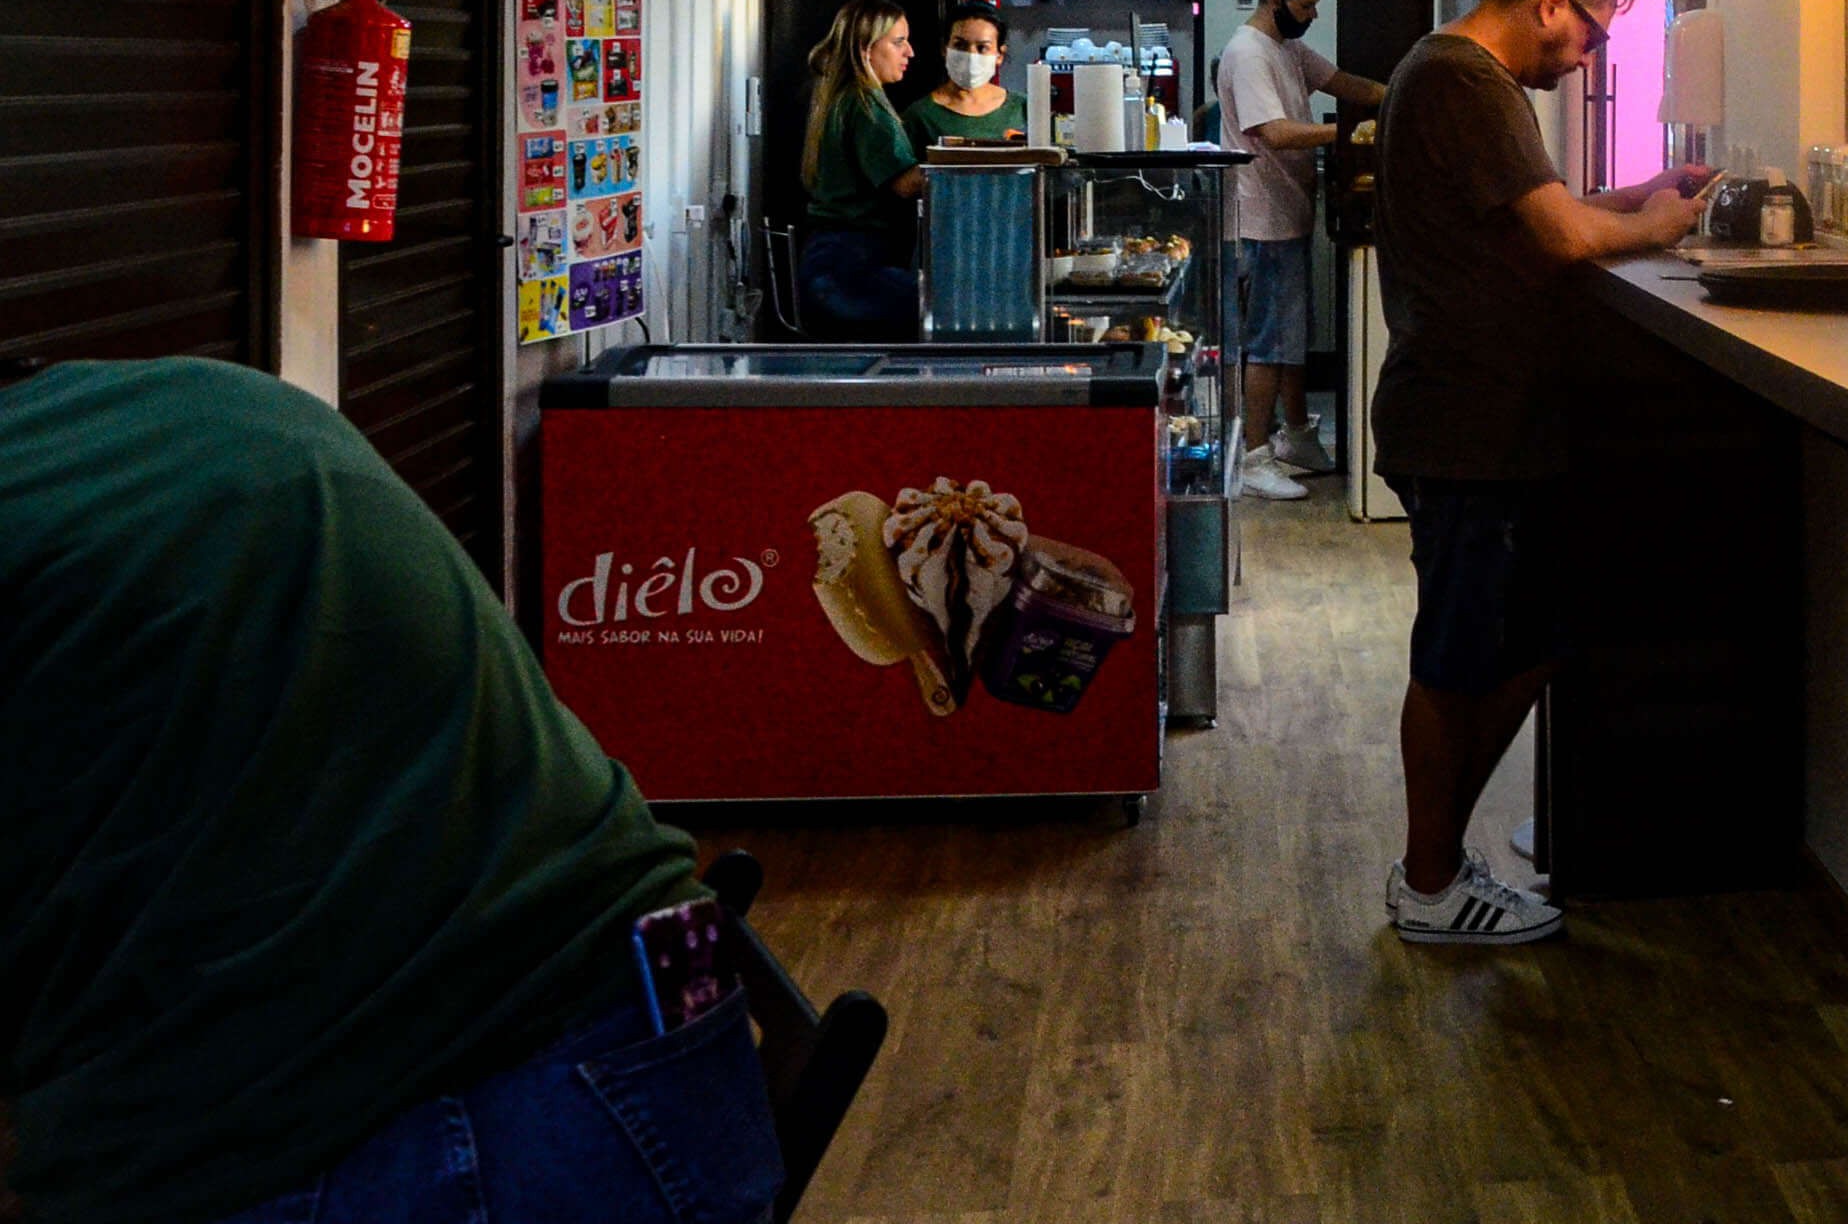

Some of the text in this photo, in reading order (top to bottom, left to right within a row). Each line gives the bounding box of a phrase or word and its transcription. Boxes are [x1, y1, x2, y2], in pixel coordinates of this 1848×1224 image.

[346, 61, 380, 209] MOCELIN
[558, 629, 764, 644] MAIS SABOR NA SUA VIDA!
